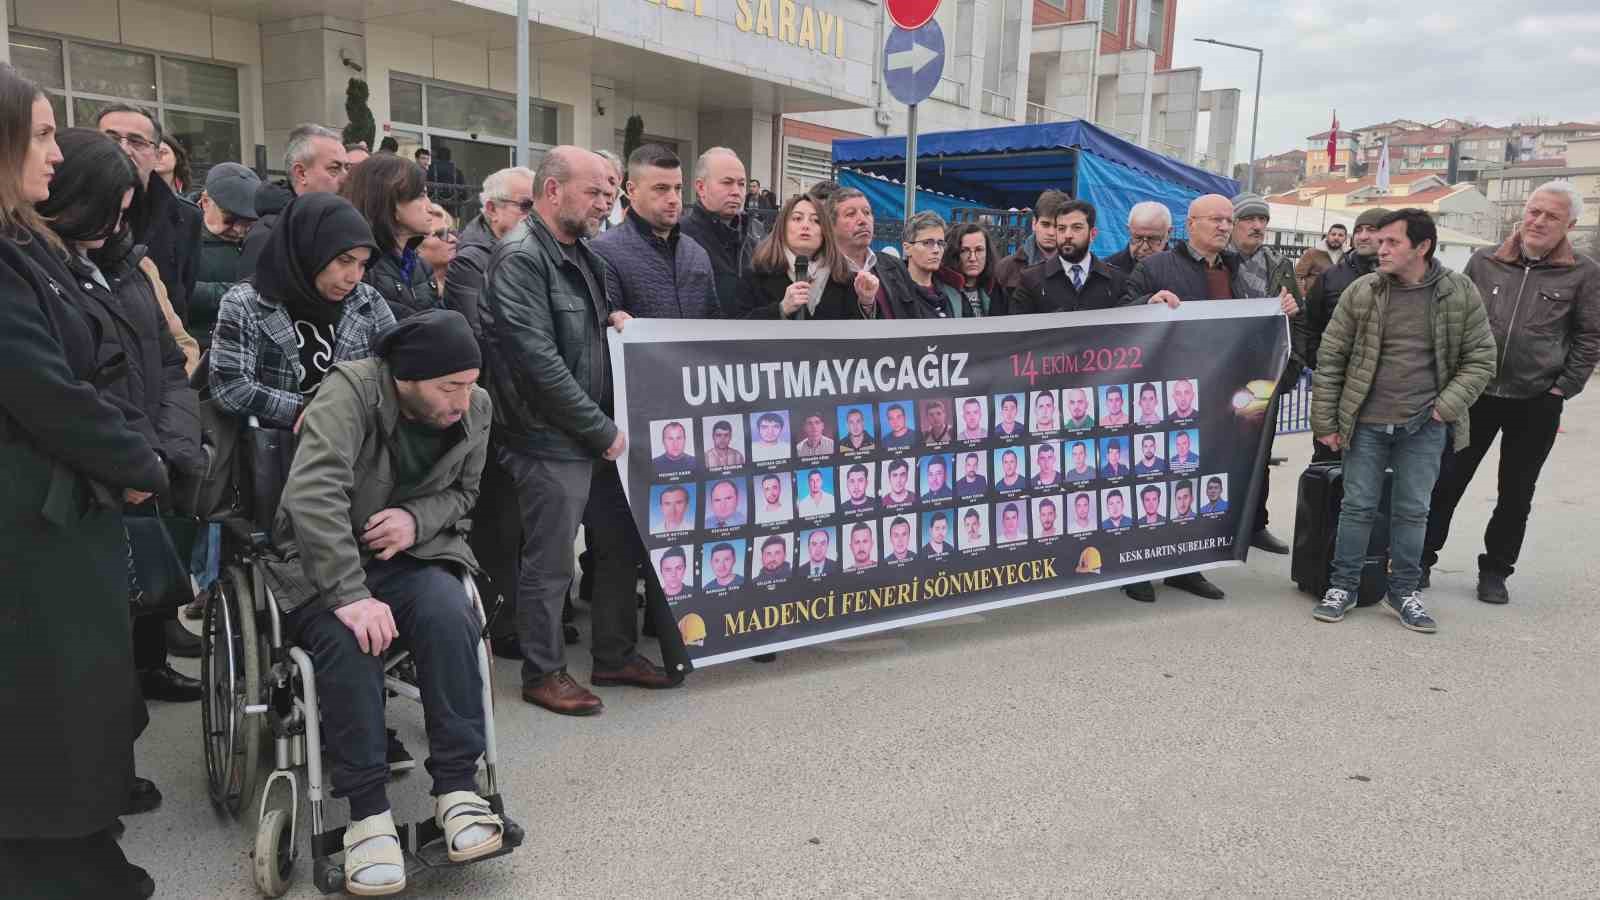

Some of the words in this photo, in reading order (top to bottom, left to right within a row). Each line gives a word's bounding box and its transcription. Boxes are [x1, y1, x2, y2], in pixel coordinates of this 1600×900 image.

[735, 0, 844, 59] SARAYI
[681, 345, 969, 406] UNUTMAYACAĞIZ
[1009, 351, 1038, 385] 14
[1081, 346, 1143, 372] 2022
[1119, 549, 1142, 563] KESK
[724, 590, 836, 637] MADENCİ
[841, 576, 920, 616] FENERİ
[923, 557, 1058, 600] SÖNMEYECEK
